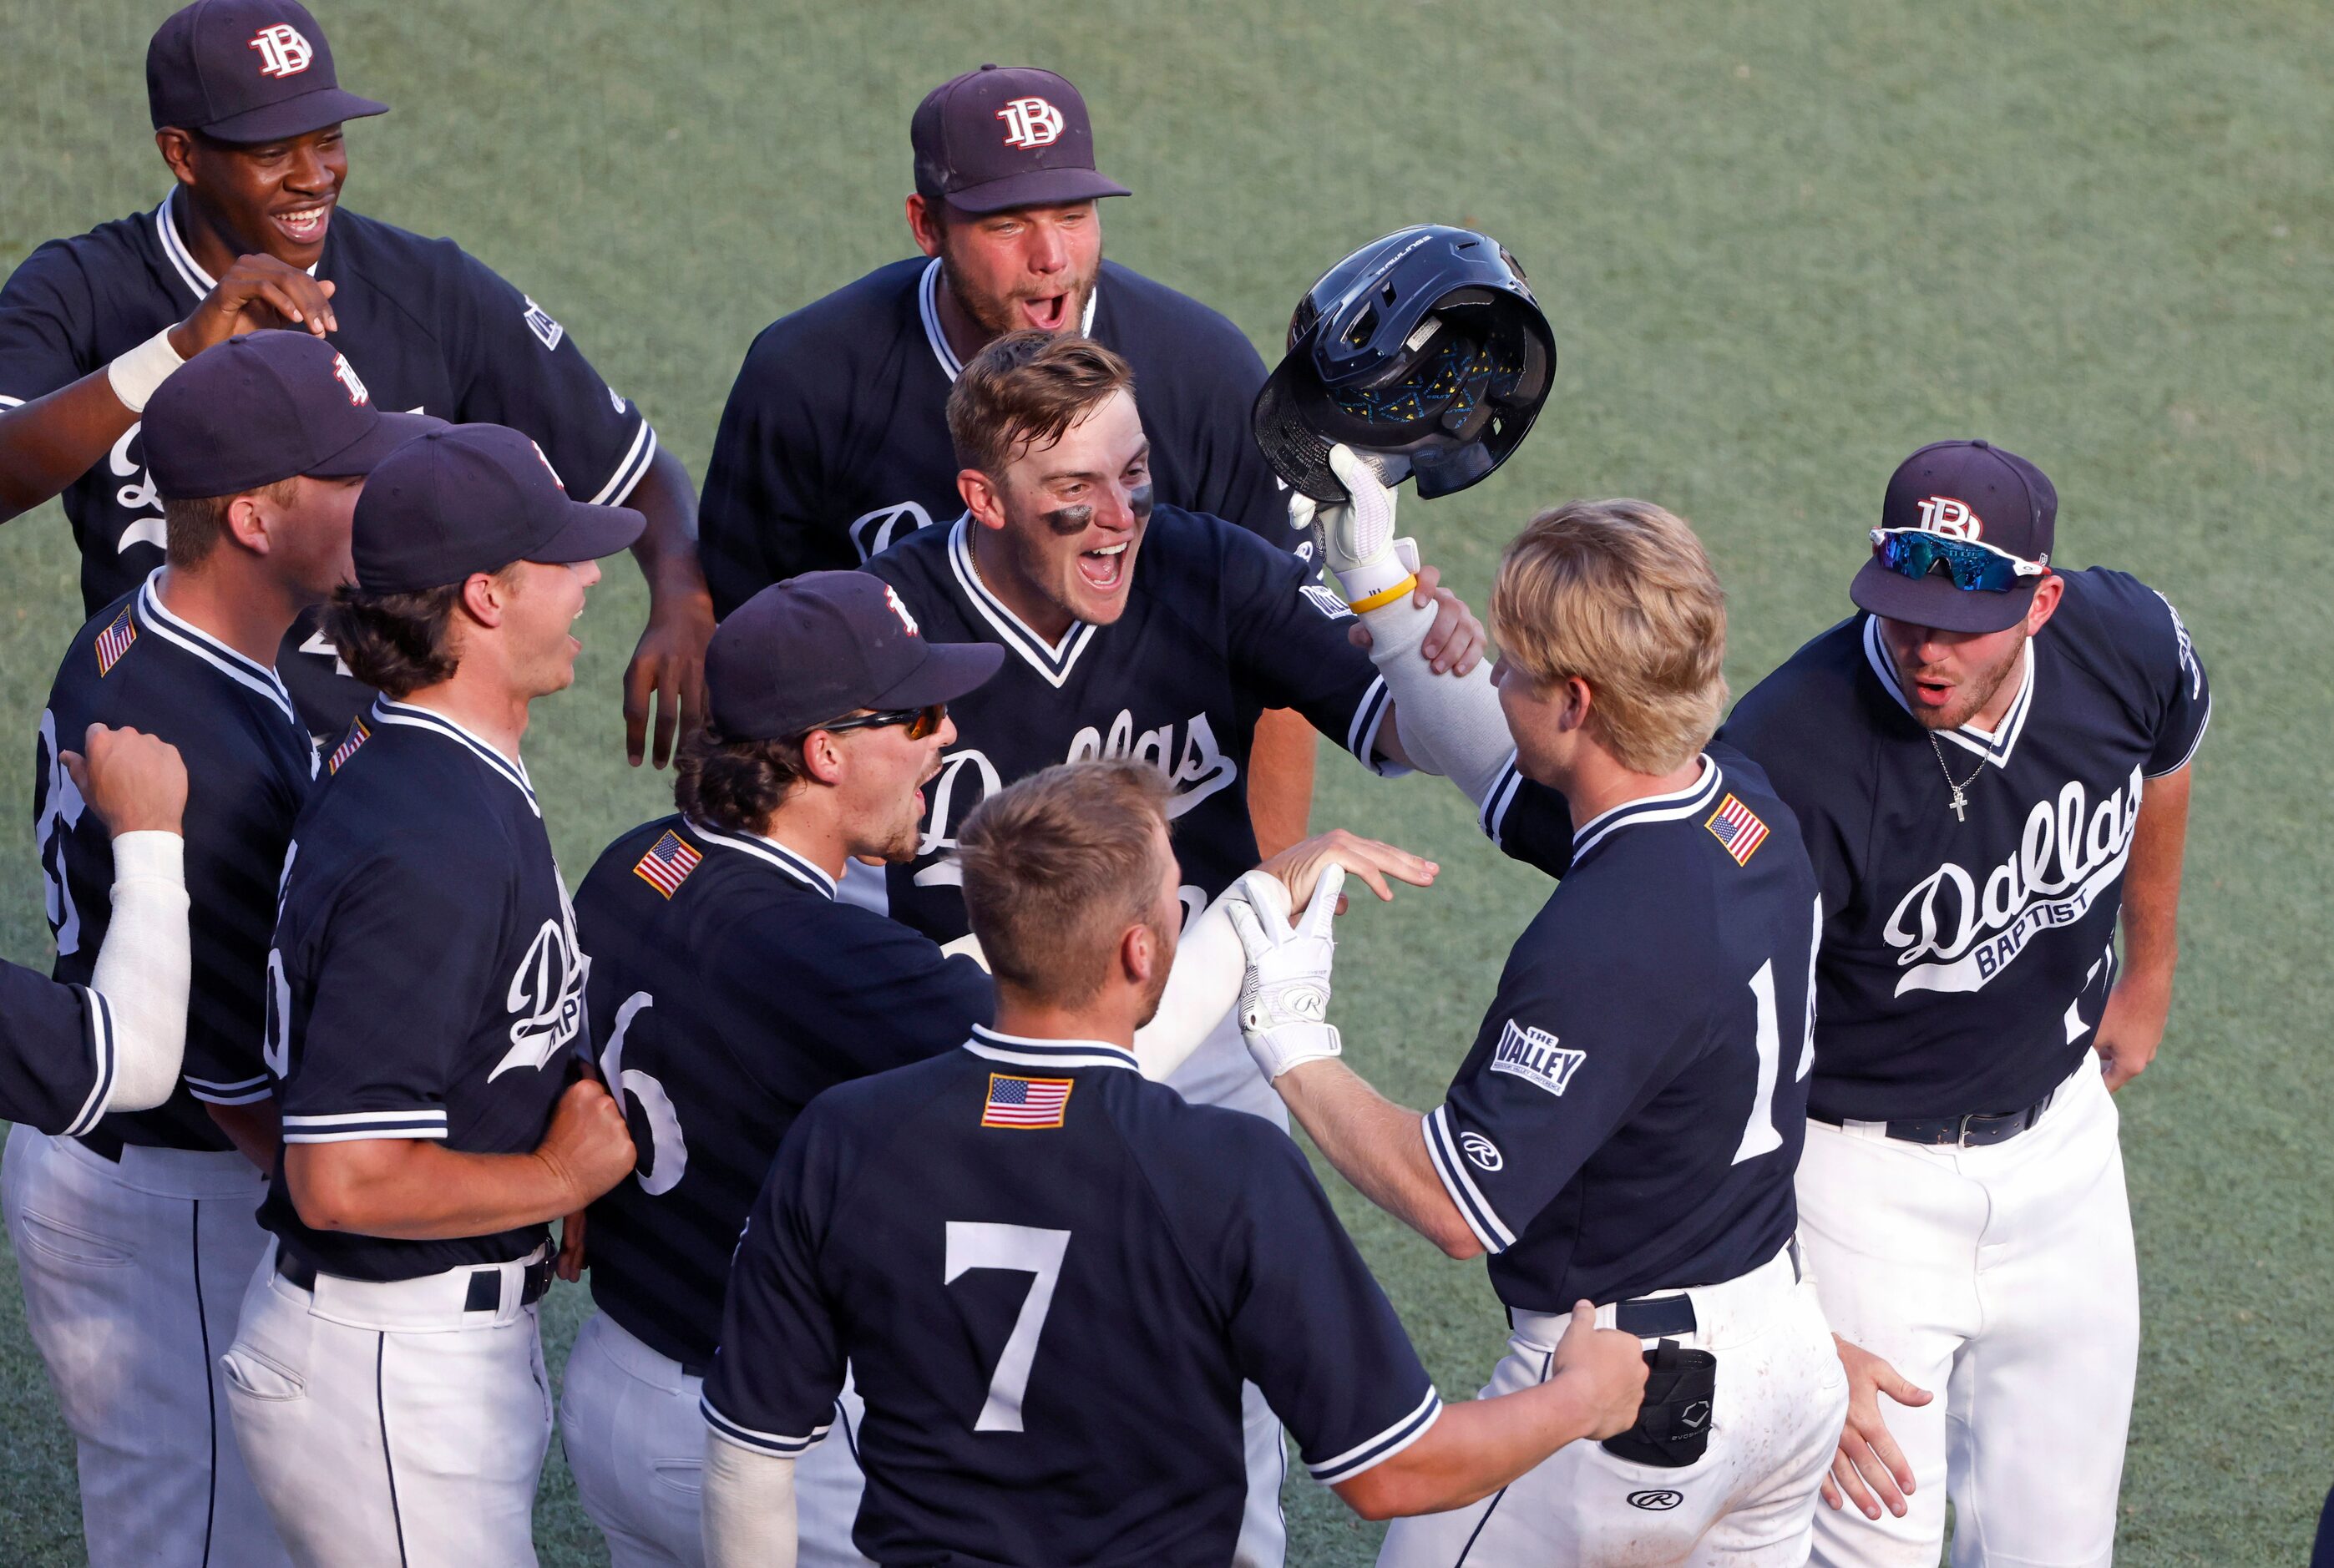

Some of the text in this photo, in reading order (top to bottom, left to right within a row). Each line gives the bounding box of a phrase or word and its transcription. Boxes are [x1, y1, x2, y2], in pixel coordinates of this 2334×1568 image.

[1375, 235, 1433, 276] RAWLINGS
[1304, 589, 1349, 615] VALL
[919, 709, 1229, 855] Das
[1883, 763, 2143, 966] Dallas
[1974, 888, 2088, 980] BAPTIST
[1497, 1023, 1582, 1085] VALLEY
[1529, 1029, 1555, 1046] THE
[944, 1221, 1071, 1432] 7
